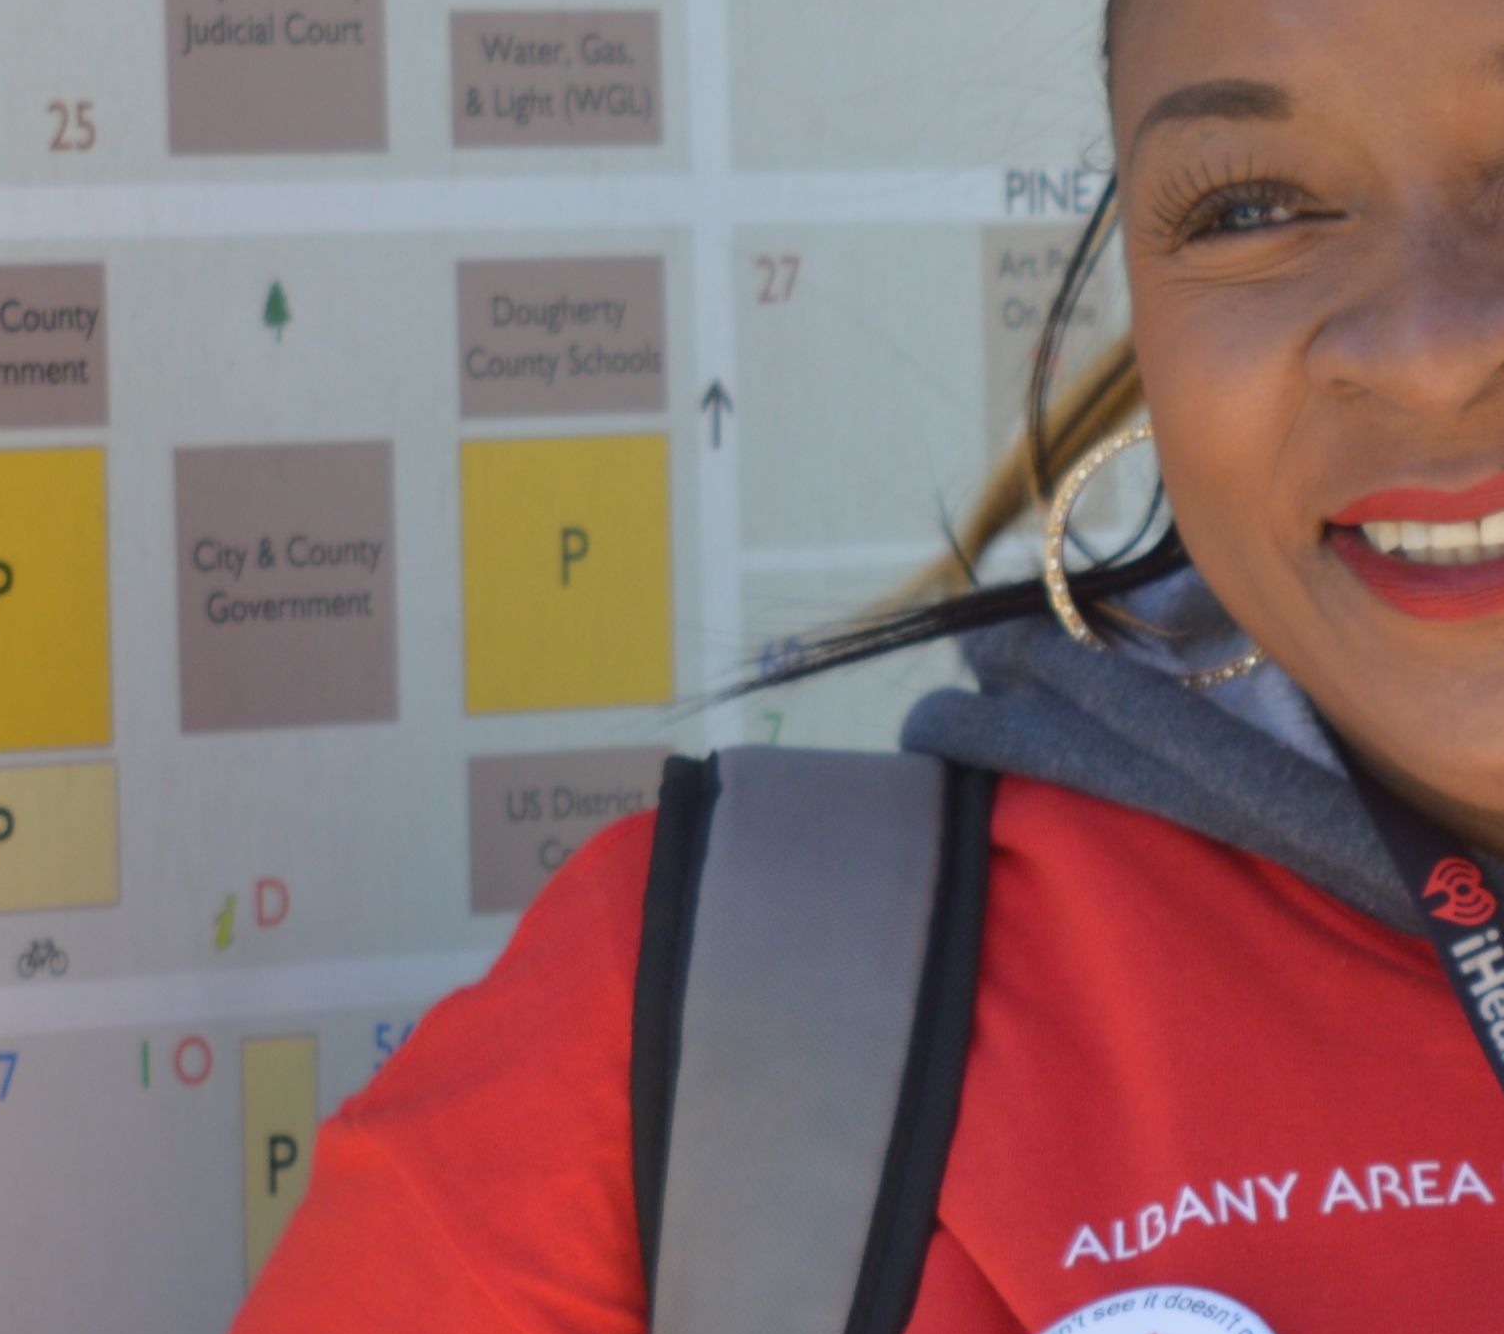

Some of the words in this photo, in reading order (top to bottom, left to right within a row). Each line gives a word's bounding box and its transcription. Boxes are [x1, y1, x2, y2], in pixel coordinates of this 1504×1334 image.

[182, 14, 272, 55] Judicial
[284, 13, 364, 46] Court
[48, 100, 97, 153] 25
[493, 85, 554, 127] Light
[562, 83, 654, 127] (WGL)
[1004, 169, 1092, 216] PINE
[755, 255, 800, 305] 27
[492, 295, 627, 337] Dougherty
[464, 344, 560, 384] County
[567, 340, 663, 377] Schools
[194, 538, 249, 575] City
[258, 538, 276, 569] &
[287, 534, 382, 573] County
[560, 526, 590, 588] P
[205, 589, 372, 626] Government
[505, 787, 542, 822] US
[255, 877, 290, 929] D
[267, 1134, 298, 1197] P
[1063, 1169, 1298, 1268] ALBANY
[1320, 1163, 1495, 1213] AREA
[1093, 1297, 1137, 1322] see
[1143, 1291, 1159, 1310] it
[1164, 1291, 1243, 1332] doesn't
